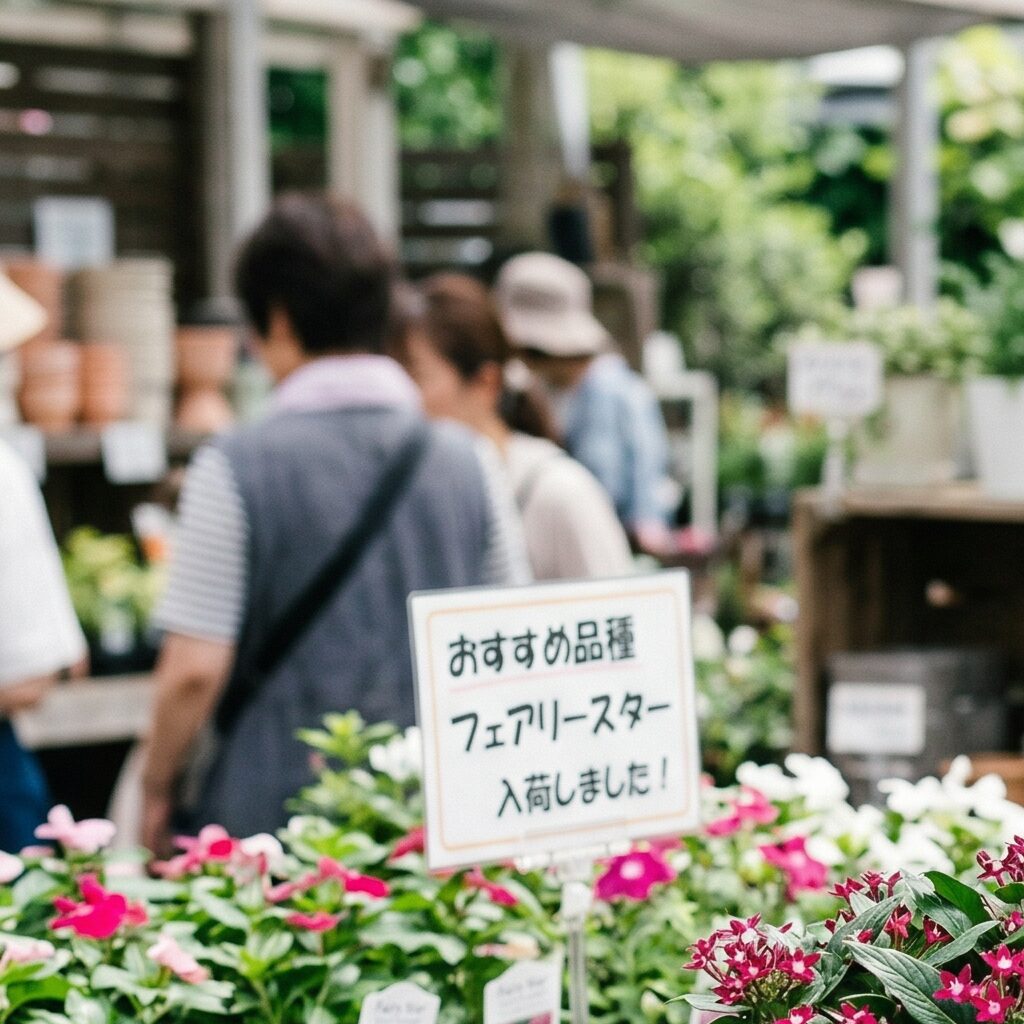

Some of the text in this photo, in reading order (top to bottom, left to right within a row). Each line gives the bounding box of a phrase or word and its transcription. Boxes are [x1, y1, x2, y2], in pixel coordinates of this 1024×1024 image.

[449, 615, 636, 677] おすすめ品種
[451, 692, 671, 752] フェアリースター
[497, 756, 669, 817] 入荷しました！
